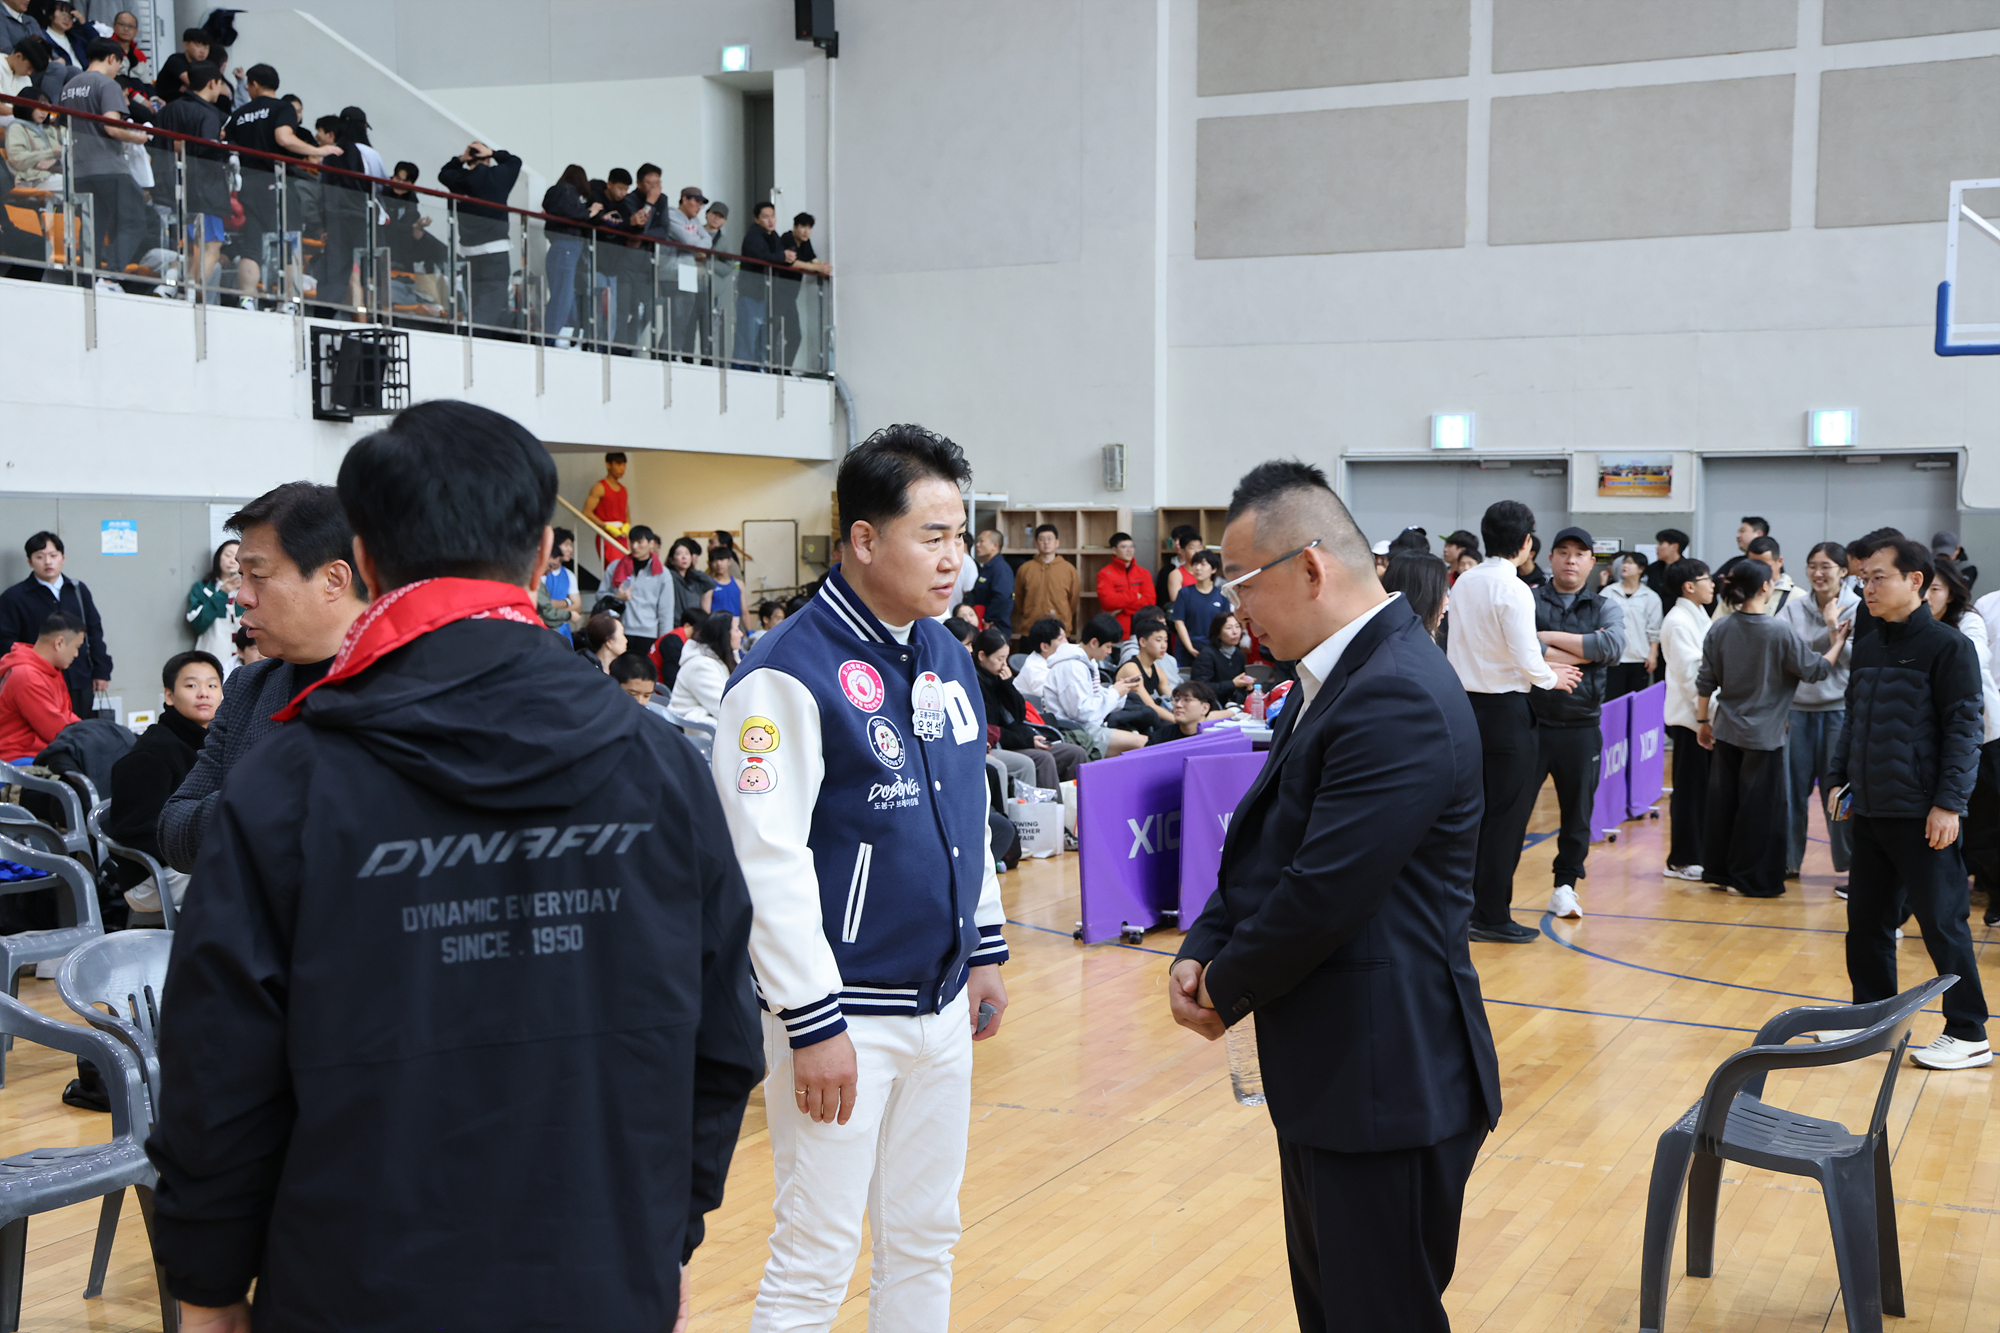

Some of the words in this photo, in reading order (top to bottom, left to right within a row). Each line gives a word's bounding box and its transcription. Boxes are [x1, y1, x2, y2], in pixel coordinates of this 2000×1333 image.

[918, 720, 941, 734] 오언석
[919, 711, 940, 721] 도봉구청장
[873, 801, 895, 810] 도봉구
[357, 823, 655, 878] DYNAFIT
[1126, 810, 1181, 859] XIO
[402, 897, 500, 932] DYNAMIC
[506, 887, 622, 920] EVERYDAY
[442, 931, 510, 964] SINCE
[532, 924, 584, 955] 1950
